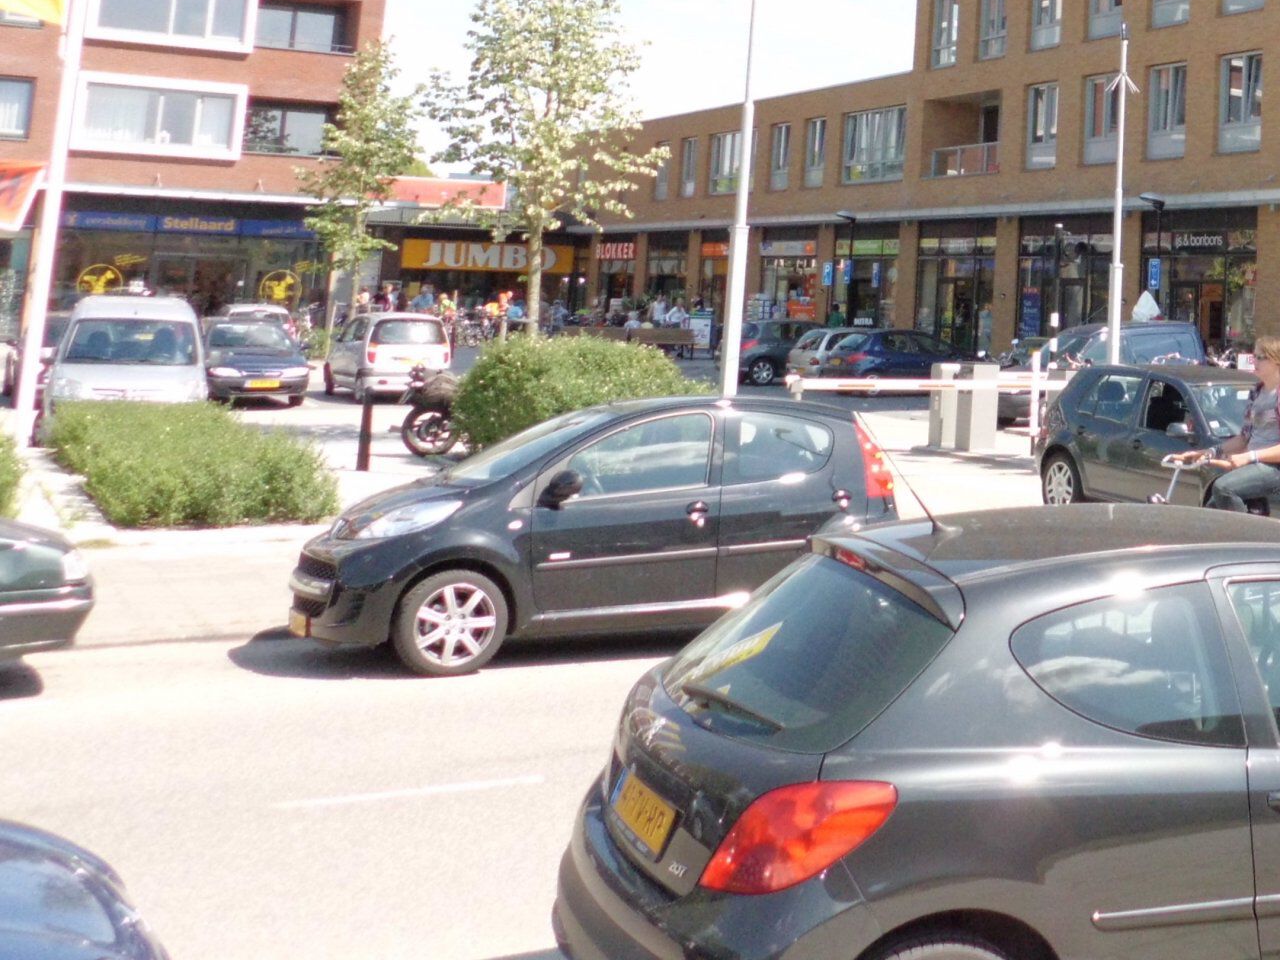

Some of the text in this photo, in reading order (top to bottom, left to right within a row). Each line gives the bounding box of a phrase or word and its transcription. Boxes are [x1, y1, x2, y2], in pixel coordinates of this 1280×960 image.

[162, 216, 236, 233] Stellaard
[1190, 234, 1223, 246] bonbons
[422, 240, 557, 272] JUMBO
[595, 241, 635, 260] BLOKKER
[668, 862, 688, 878] 207
